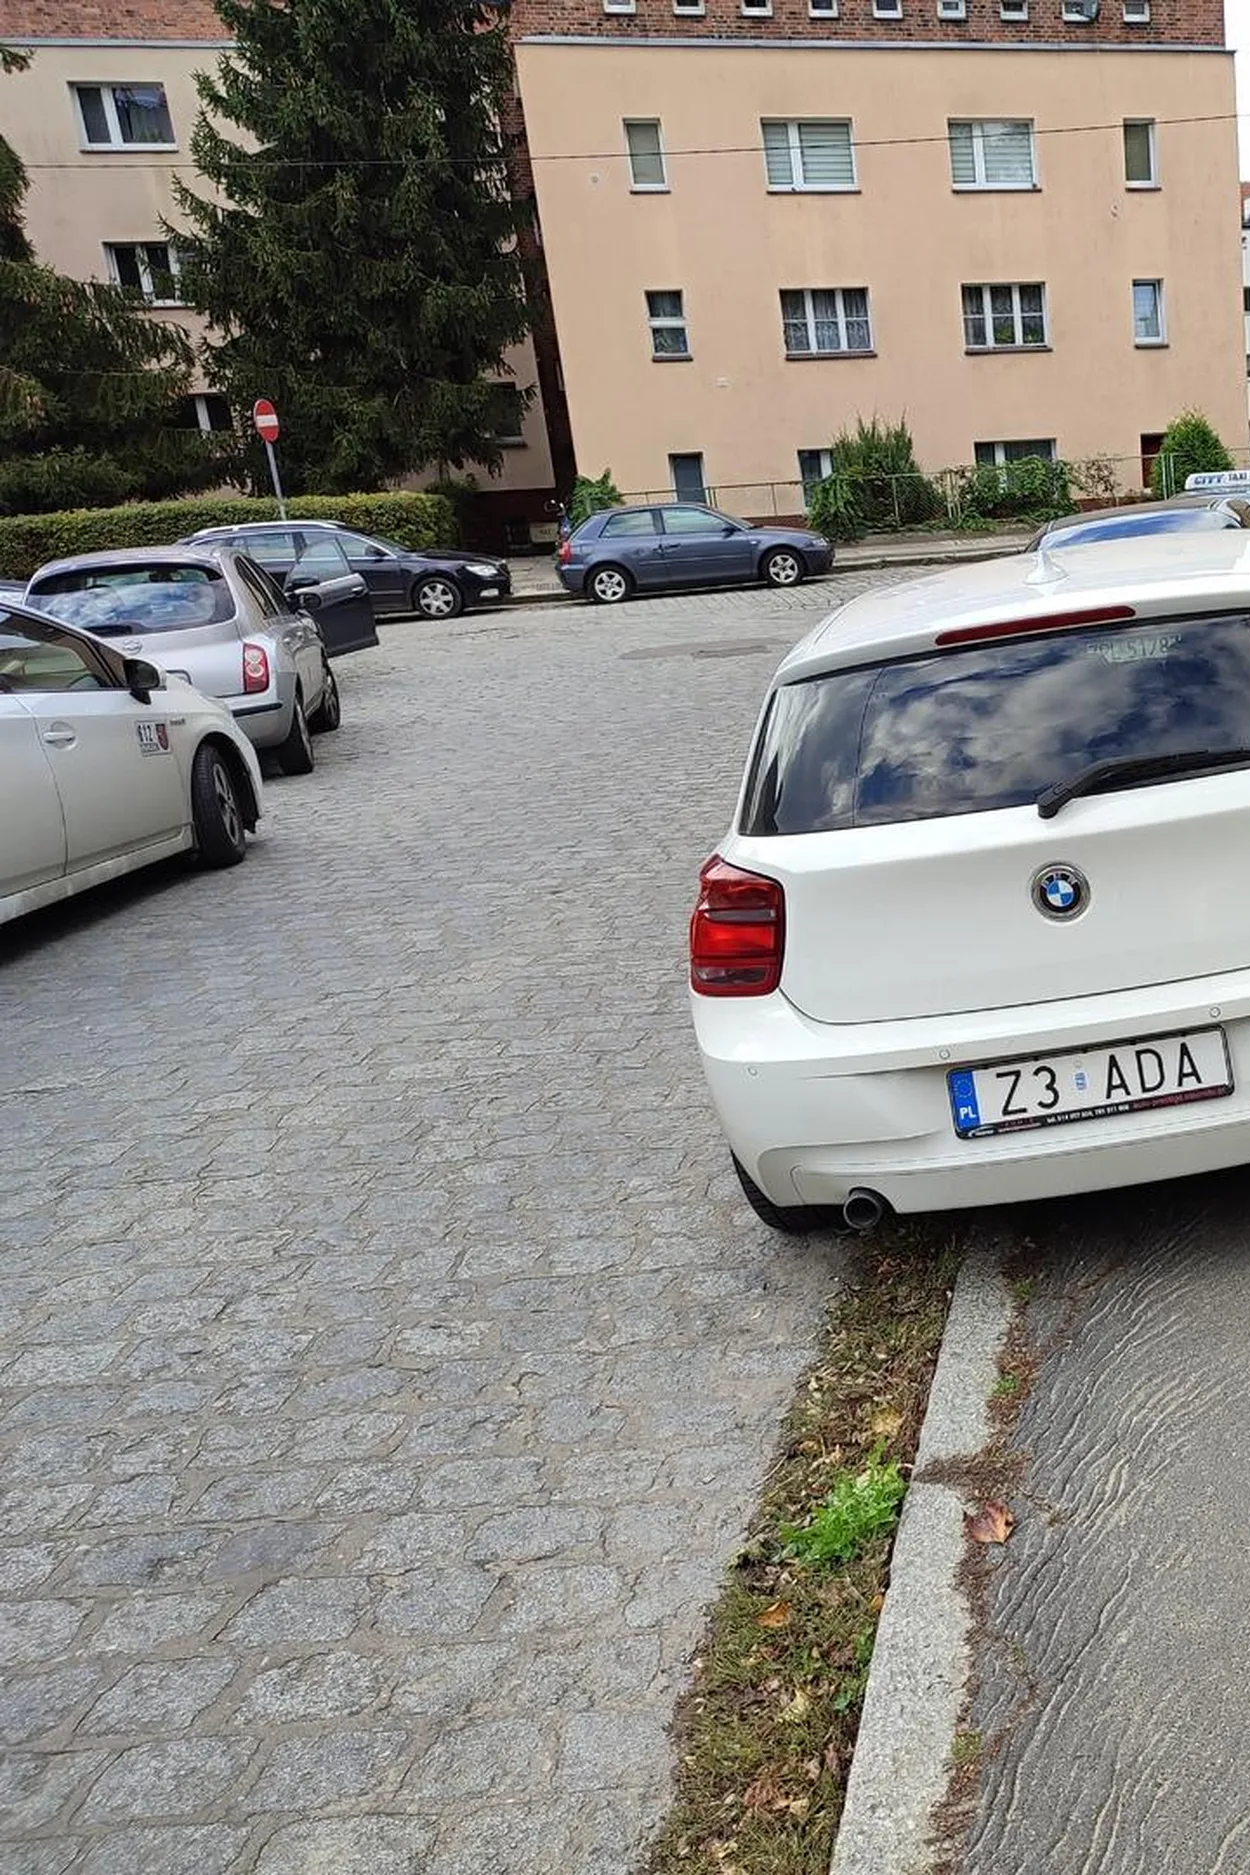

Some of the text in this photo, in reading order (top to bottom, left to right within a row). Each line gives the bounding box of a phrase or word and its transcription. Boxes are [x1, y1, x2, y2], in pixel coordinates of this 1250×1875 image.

[1194, 473, 1224, 485] CITY
[1228, 472, 1247, 481] TAXI
[996, 1041, 1203, 1117] Z3 ADA
[959, 1106, 976, 1120] PL
